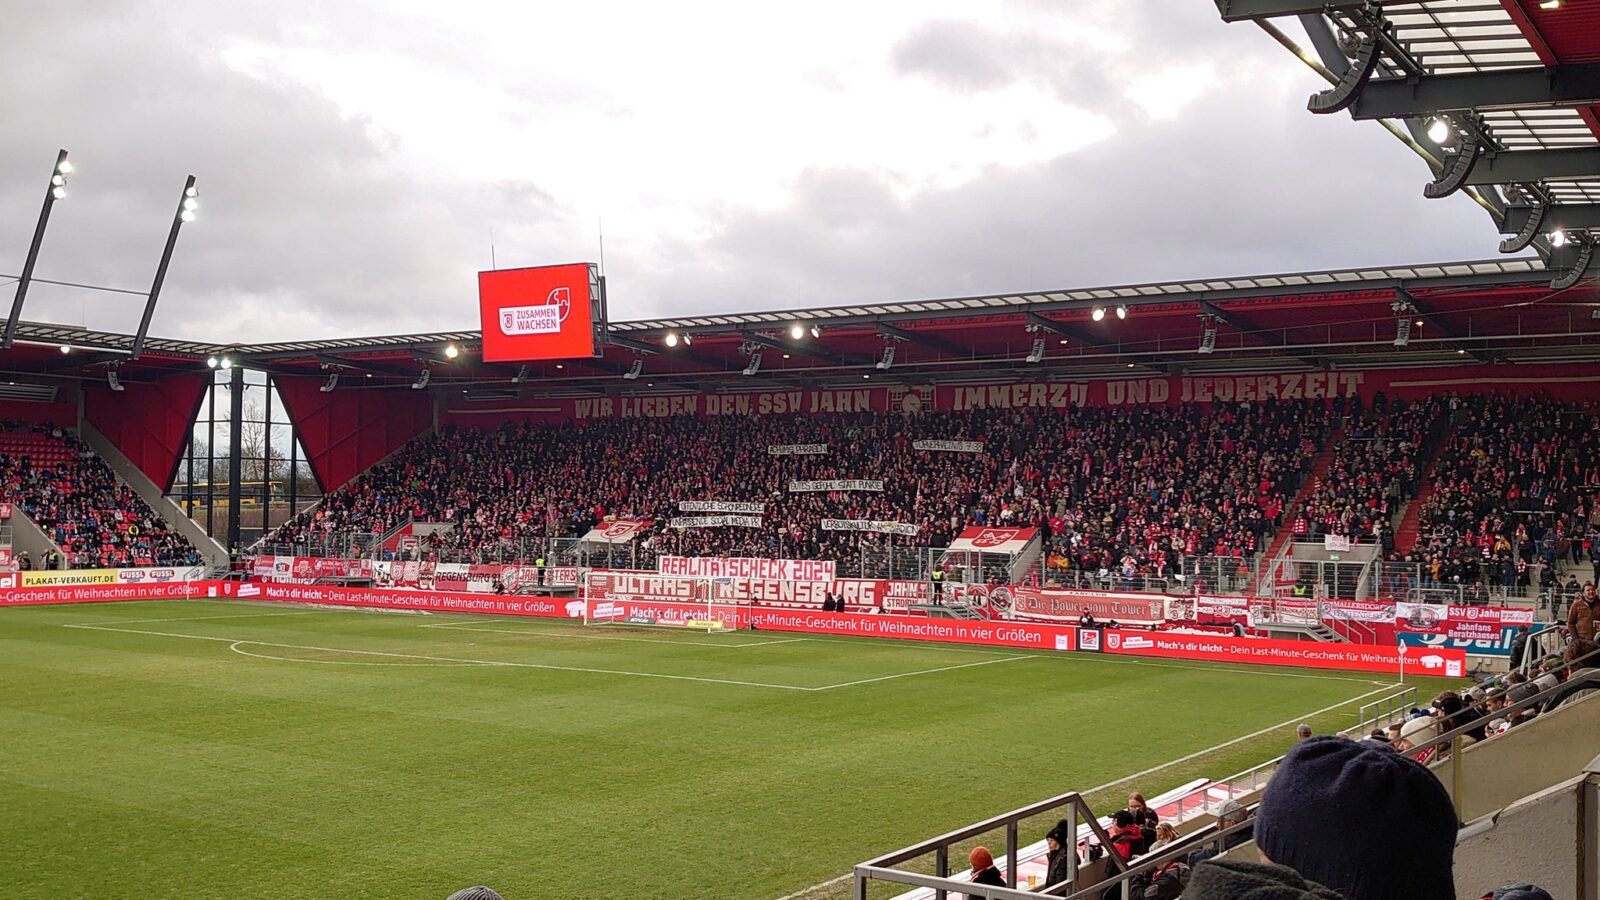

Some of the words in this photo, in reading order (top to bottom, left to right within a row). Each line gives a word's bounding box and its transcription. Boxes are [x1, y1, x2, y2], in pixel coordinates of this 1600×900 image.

[516, 309, 556, 319] ZUSAMMEN
[517, 319, 557, 330] WACHSEN
[953, 384, 1089, 410] IMMERZU
[1106, 379, 1169, 404] UND
[1180, 372, 1364, 402] JEDERZEIT
[575, 398, 613, 418] WIR
[621, 395, 698, 418] LIEBEN
[758, 391, 803, 414] SSV
[810, 390, 870, 412] JAHN
[121, 571, 145, 579] FUSSL
[151, 570, 174, 578] FUSSL
[662, 556, 787, 580] REALITÄTSCHECK
[793, 560, 833, 581] 2024
[26, 575, 114, 585] PLAKAT-VERKAUFT.DE
[436, 571, 490, 583] REGENSBURG
[57, 590, 72, 600] für
[74, 587, 136, 600] Weihnachten
[138, 585, 146, 596] in
[151, 584, 165, 595] vier
[167, 583, 199, 596] Größen
[614, 577, 691, 597] ULTRAS
[719, 578, 875, 605] REGENSBURG
[887, 582, 918, 597] JAHN
[266, 587, 289, 598] Mach's
[291, 588, 301, 598] dir
[302, 588, 322, 599] leicht
[329, 590, 346, 601] Dein
[347, 592, 428, 604] Last-Minute-Geschenk
[430, 596, 440, 605] für
[443, 597, 494, 608] Weihnachten
[497, 600, 504, 608] in
[506, 600, 524, 610] vier
[524, 600, 555, 613] Größen
[1029, 598, 1047, 609] Die
[1051, 599, 1083, 614] Power
[1111, 601, 1147, 616] Tower
[1449, 607, 1466, 617] SSV
[1478, 609, 1500, 619] Jahn
[630, 607, 662, 619] Mach's
[664, 608, 678, 620] dir
[679, 609, 708, 621] leicht
[717, 610, 740, 624] Dein
[743, 613, 857, 630] Last-Minute-Geschenk
[860, 619, 875, 632] für
[879, 620, 952, 637] Weihnachten
[957, 628, 967, 638] in
[970, 628, 992, 640] vier
[996, 627, 1041, 643] Größen
[1456, 622, 1492, 633] Jahnfans
[1448, 630, 1500, 641] Beratzhausen
[1157, 640, 1185, 651] Mach's
[1186, 641, 1198, 652] dir
[1199, 643, 1223, 653] leicht
[1231, 645, 1250, 655] Dein
[1252, 646, 1344, 661] Last-Minute-Geschenk
[1346, 651, 1358, 662] für
[1360, 653, 1419, 665] Weihnachten
